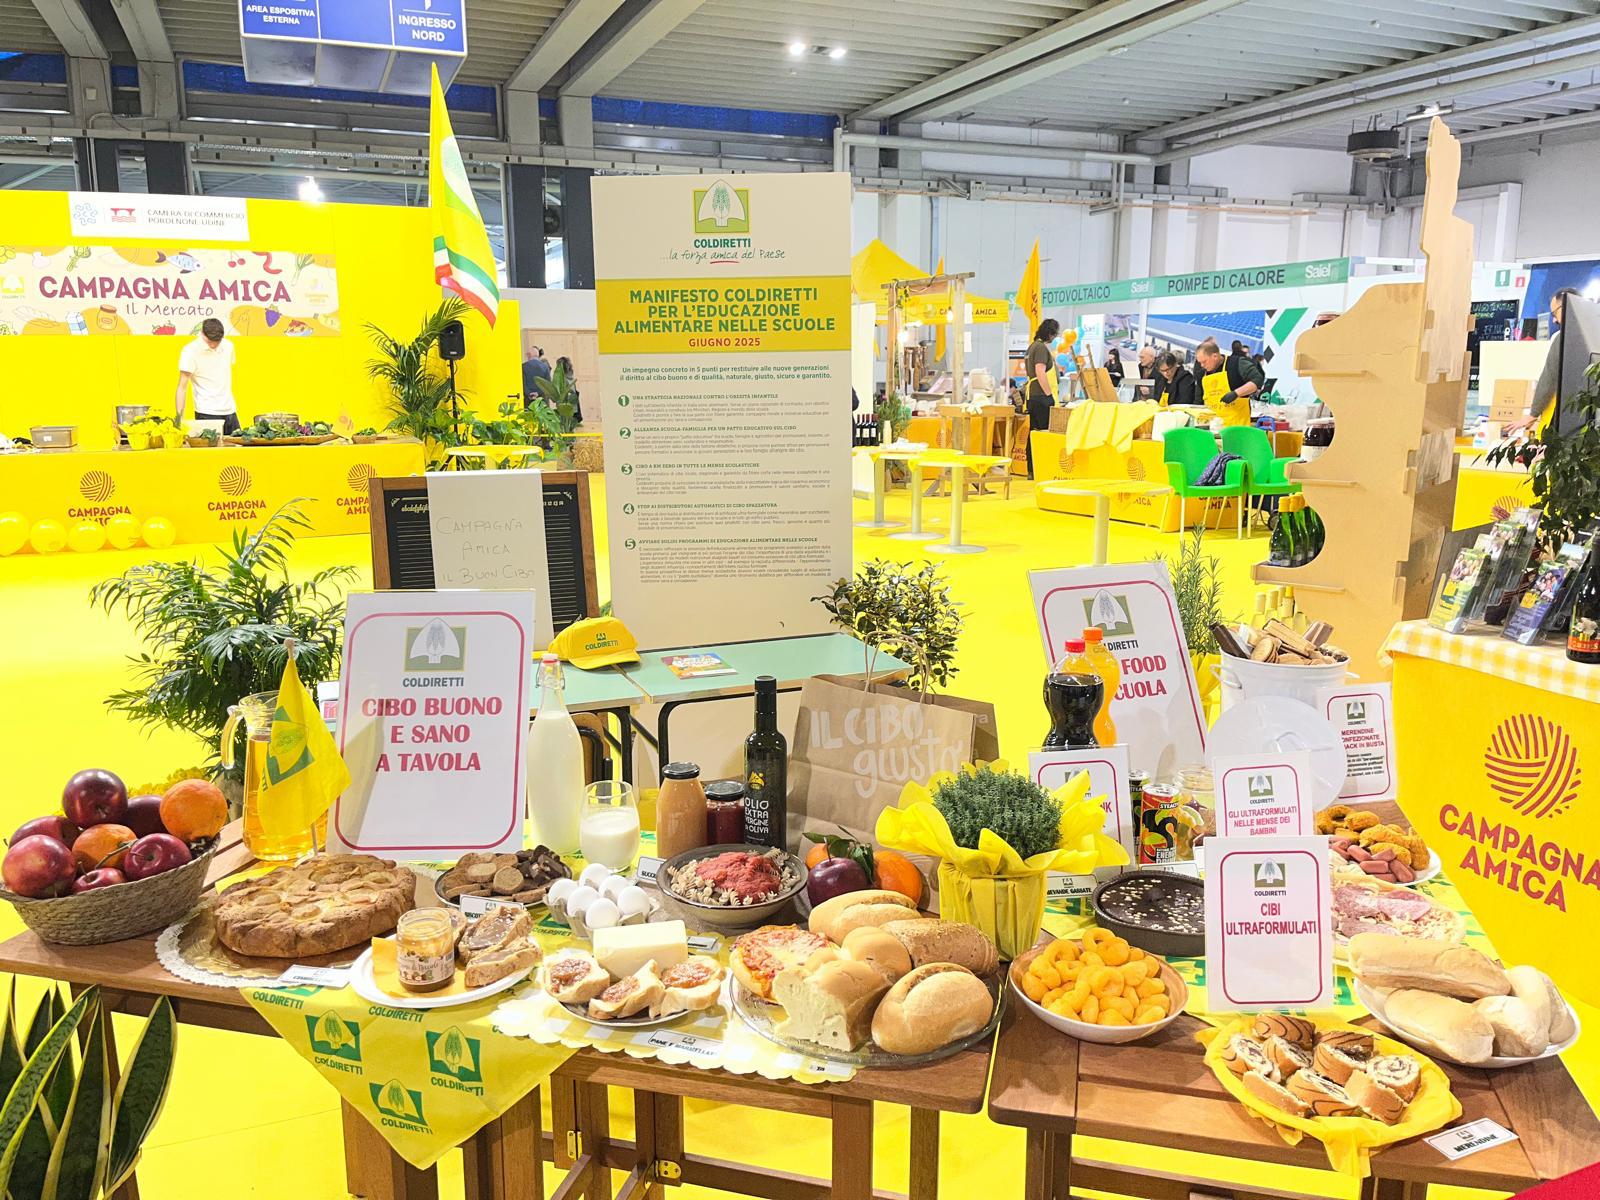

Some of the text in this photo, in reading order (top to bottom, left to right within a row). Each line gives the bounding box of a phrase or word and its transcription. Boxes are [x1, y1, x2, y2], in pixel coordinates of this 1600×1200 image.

[246, 5, 315, 17] AREA ESPOSITIVA
[263, 15, 300, 25] ESTERNA
[398, 15, 456, 30] INGRESSO
[412, 29, 445, 42] NORD
[148, 209, 182, 217] CAMERA
[194, 210, 245, 219] COMMERCIO
[694, 238, 751, 248] COLDIRETTI
[681, 248, 786, 264] forza amica del Paese
[1168, 269, 1286, 292] POMPE DI CALORE
[39, 276, 190, 300] CAMPAGNA
[199, 278, 292, 302] AMICA
[630, 287, 818, 304] MANIFESTO COLDIRETTI
[1042, 286, 1112, 304] FOTOVOLTAICO
[126, 303, 214, 317] Il Mercato
[648, 304, 678, 318] PER
[614, 318, 835, 334] ALIMENTARE NELLE SCUOLE
[688, 338, 760, 347] GIUGNO 2025
[207, 500, 267, 512] CAMPAGNA
[336, 496, 369, 507] CAMPA
[68, 506, 132, 518] CAMPAGNA
[219, 509, 258, 521] AMICA
[346, 506, 370, 516] AMI
[585, 640, 618, 650] COLDIRETTI
[1122, 656, 1166, 674] FOOD
[402, 677, 464, 688] COLDIRETTI
[1114, 680, 1167, 700] CUOLA
[362, 696, 502, 716] CIBO BUONO
[810, 703, 924, 749] IL CIBO
[390, 724, 470, 744] E SANO
[376, 752, 481, 772] A TAVOLA
[745, 797, 769, 810] OLIO
[745, 807, 768, 818] EXTRA
[1228, 806, 1297, 818] GLI ULTRAFORMULATI
[1234, 816, 1290, 828] NELLE MENSE DEI
[749, 825, 768, 834] OLIVA
[1250, 827, 1277, 836] BAMBINI
[1439, 803, 1600, 891] CAMPAGNA
[1459, 845, 1567, 913] AMICA
[1260, 903, 1280, 916] CIBI
[1226, 921, 1316, 935] ULTRAFORMULATI
[252, 990, 303, 1010] COLDIRETTI
[368, 1006, 424, 1022] COLDIRETTI
[314, 1056, 363, 1075] COLDIRETTI
[430, 1076, 484, 1096] COLDIRETTI
[381, 1117, 434, 1135] COLDIRETTI
[1454, 1134, 1498, 1152] MERENDINE
